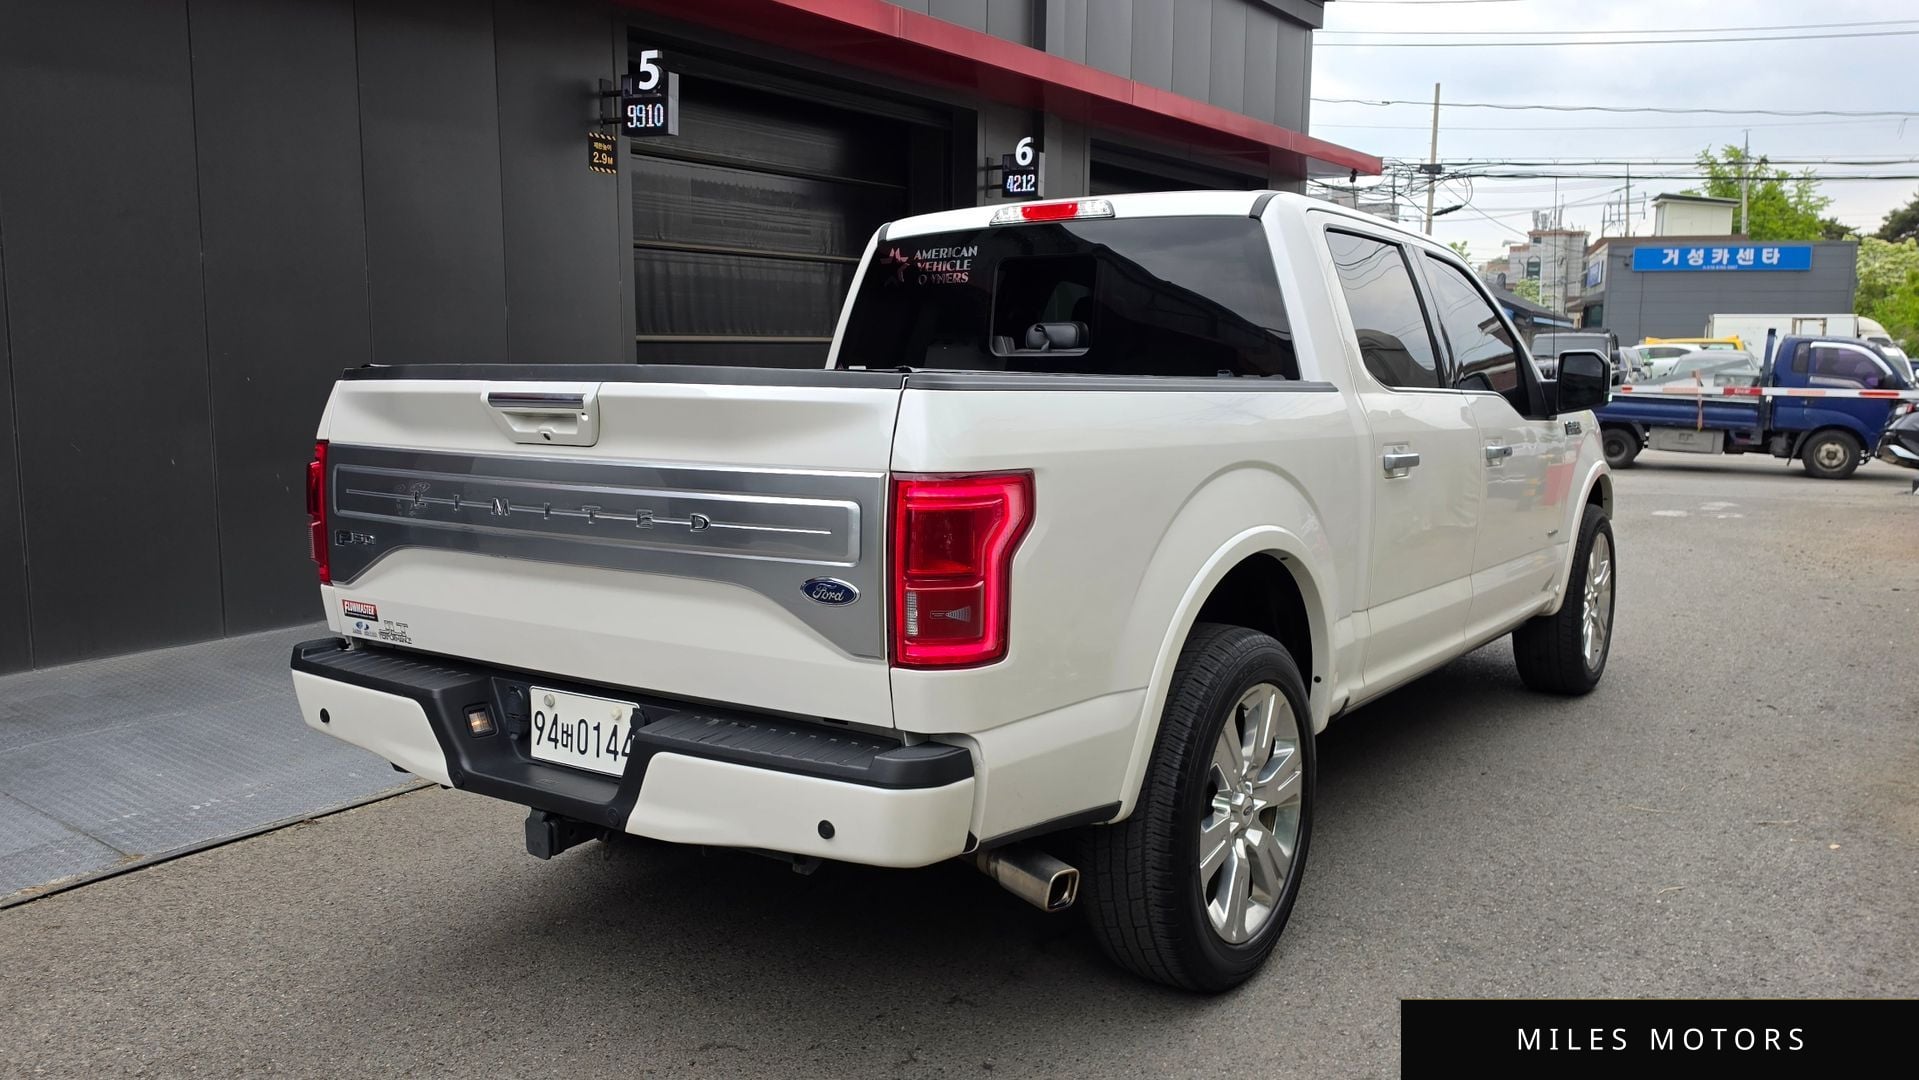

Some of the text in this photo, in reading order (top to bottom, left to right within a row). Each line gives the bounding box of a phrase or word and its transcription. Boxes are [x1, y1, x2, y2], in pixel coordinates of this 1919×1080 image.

[638, 49, 660, 91] 5
[627, 103, 664, 128] 9910
[1015, 136, 1034, 167] 6
[1006, 174, 1035, 192] 4212
[914, 245, 978, 260] AMERICAN
[1661, 247, 1781, 266] 거성카센타
[916, 259, 972, 272] VEHICLE
[413, 489, 711, 532] LIMITED
[811, 583, 845, 602] Ford
